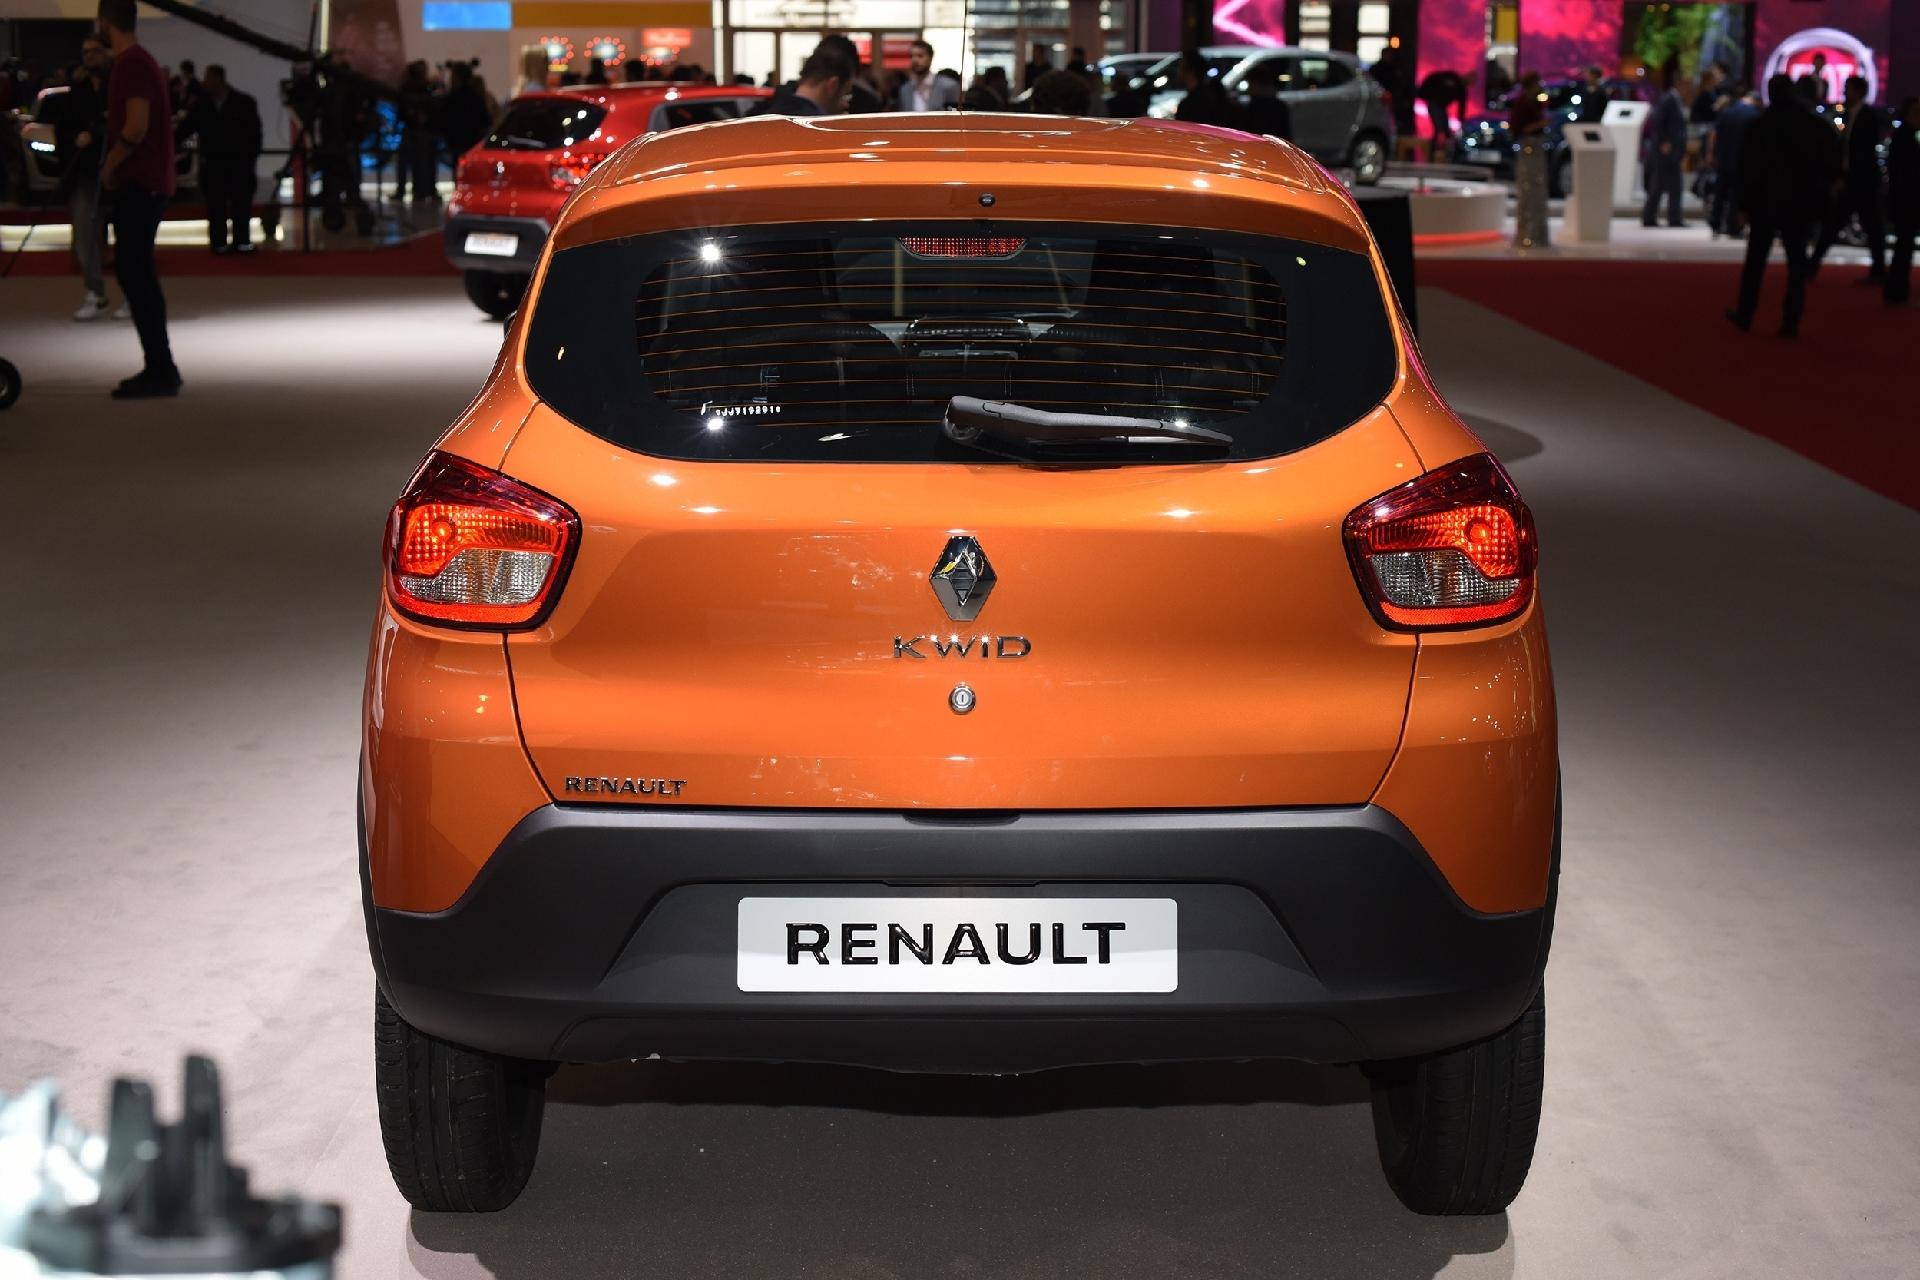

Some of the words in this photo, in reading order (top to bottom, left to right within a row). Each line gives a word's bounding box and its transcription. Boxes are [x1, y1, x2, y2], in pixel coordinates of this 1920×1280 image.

[894, 635, 1031, 658] KWID
[565, 777, 687, 795] RENAULT
[786, 923, 1126, 965] RENAULT
